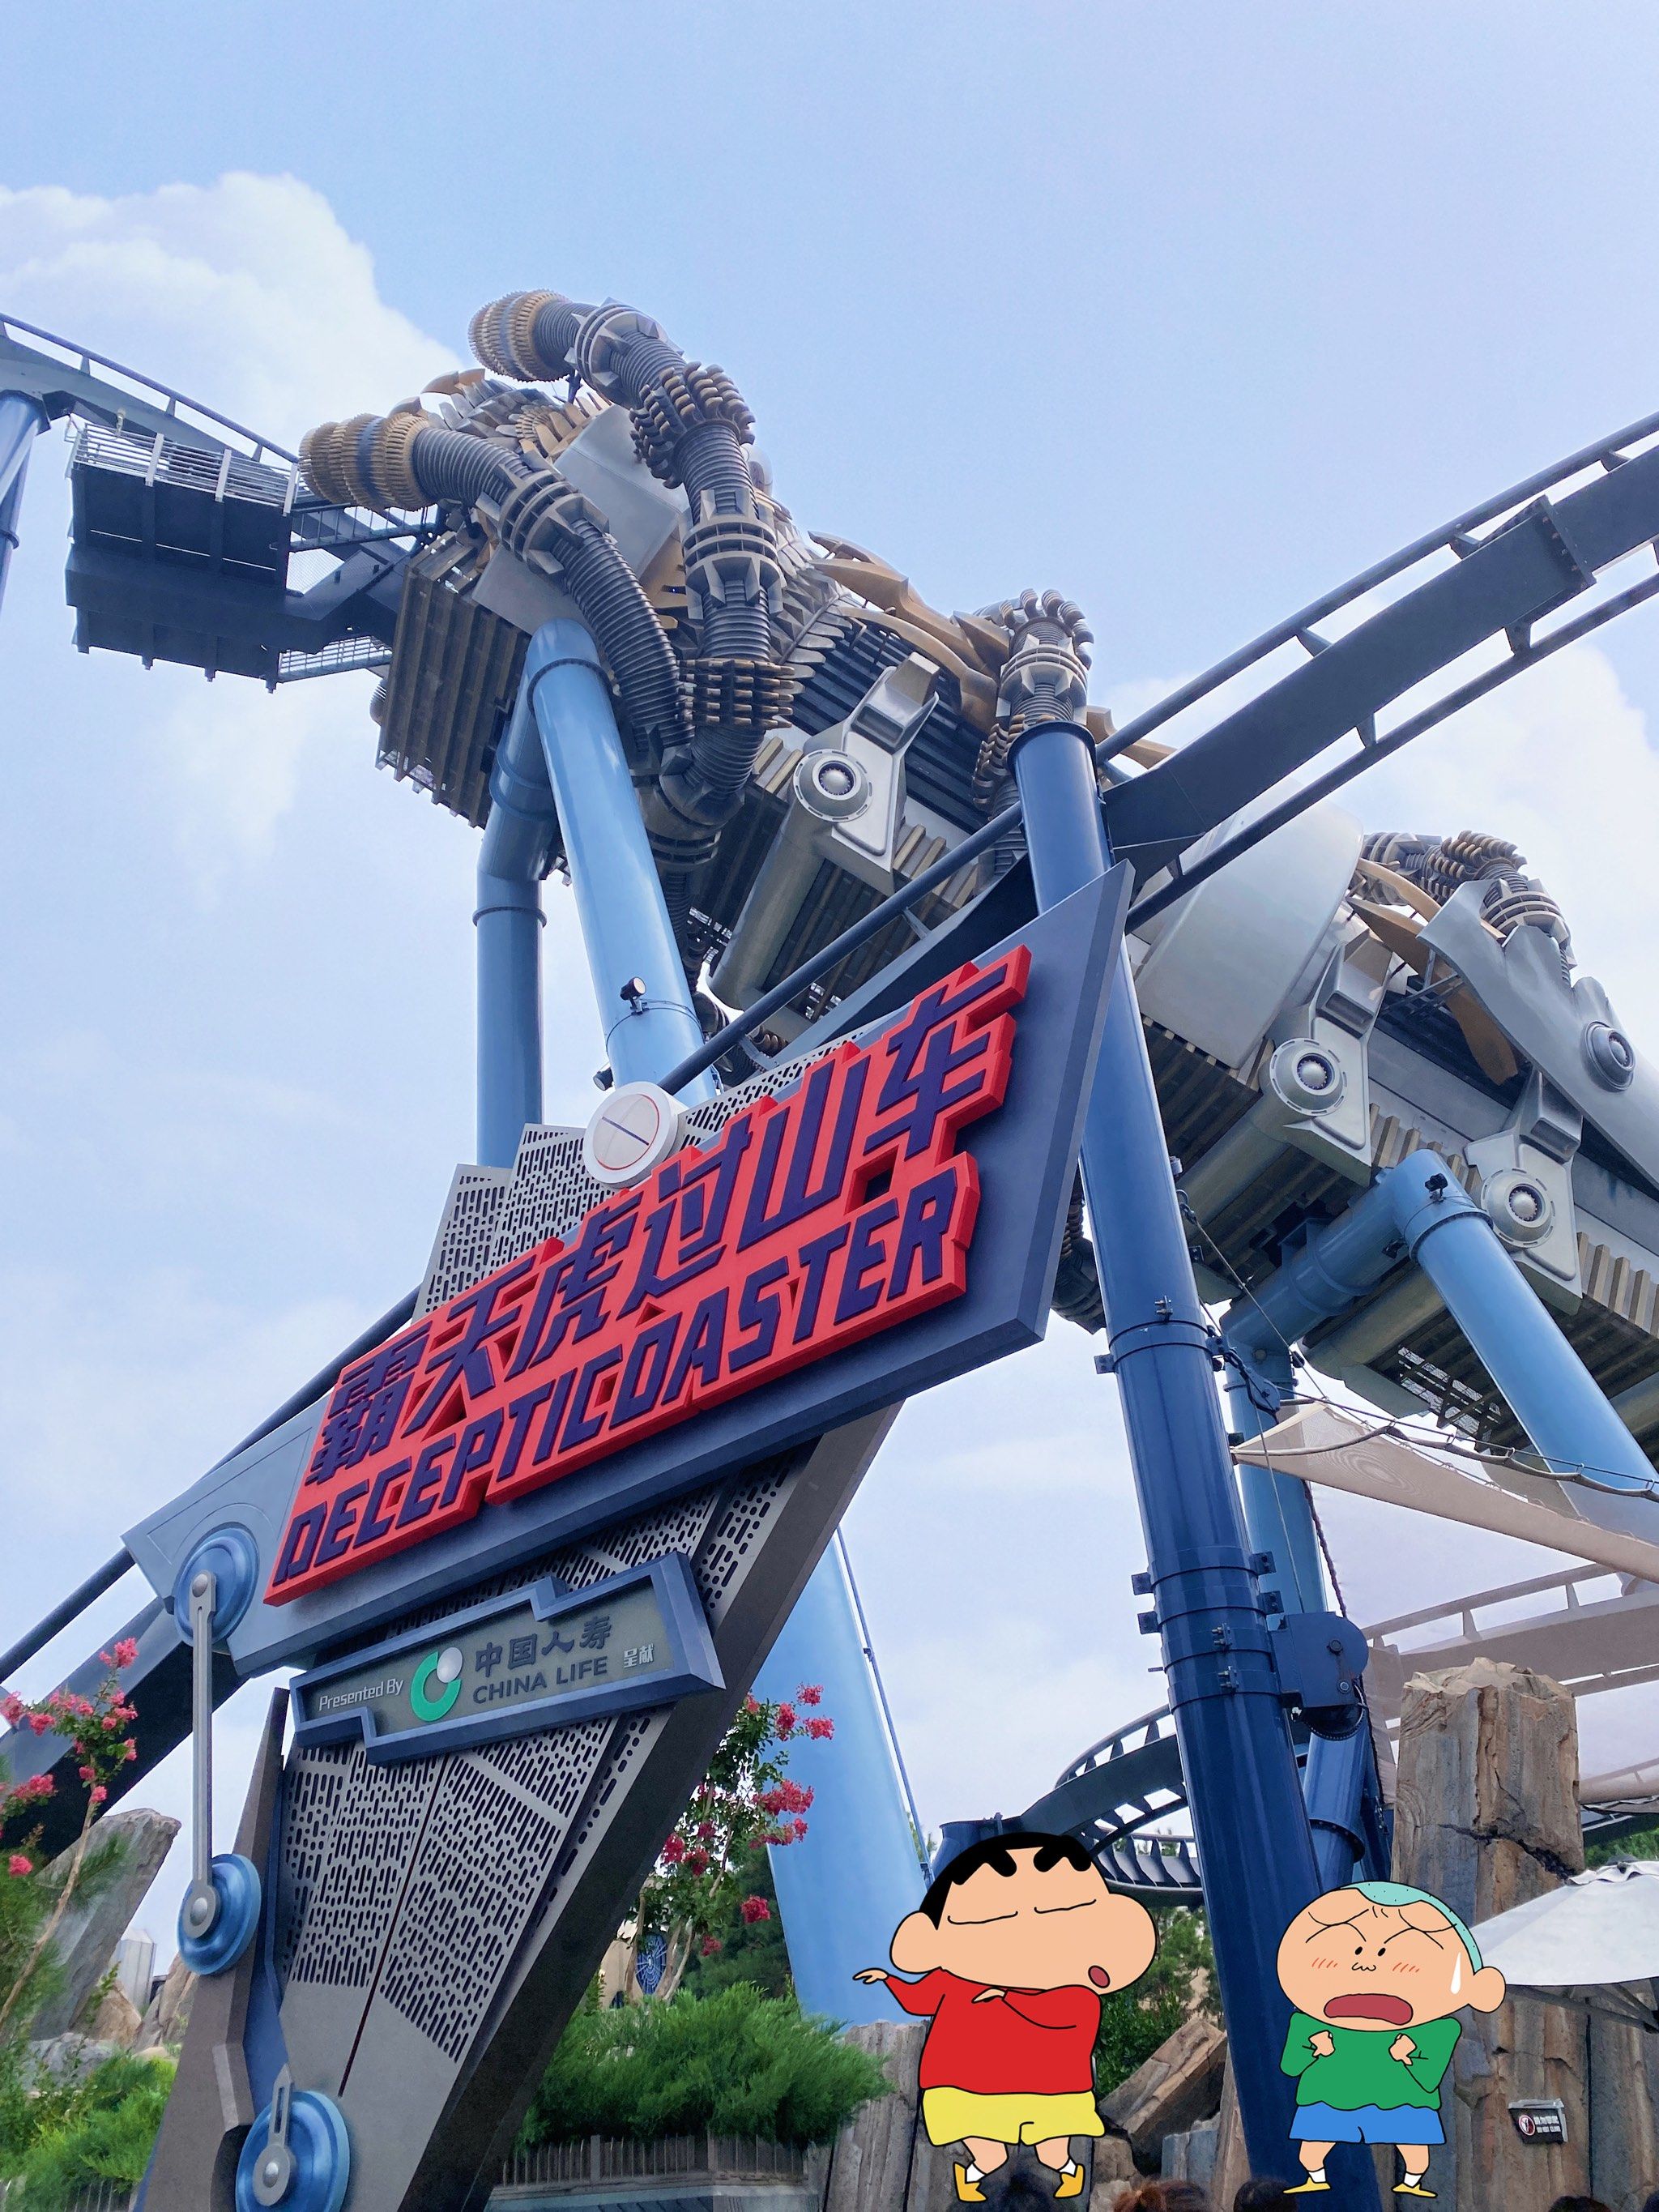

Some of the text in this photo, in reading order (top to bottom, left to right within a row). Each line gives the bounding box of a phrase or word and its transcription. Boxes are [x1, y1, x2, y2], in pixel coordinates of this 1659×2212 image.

[305, 963, 1008, 1486] 霸天虎过山车
[273, 1176, 957, 1585] DECEPTICOASTER
[476, 1616, 612, 1677] 中国人寿
[624, 1643, 655, 1668] 呈献
[319, 1678, 404, 1710] Presented By
[473, 1655, 608, 1704] CHINA LIFE
